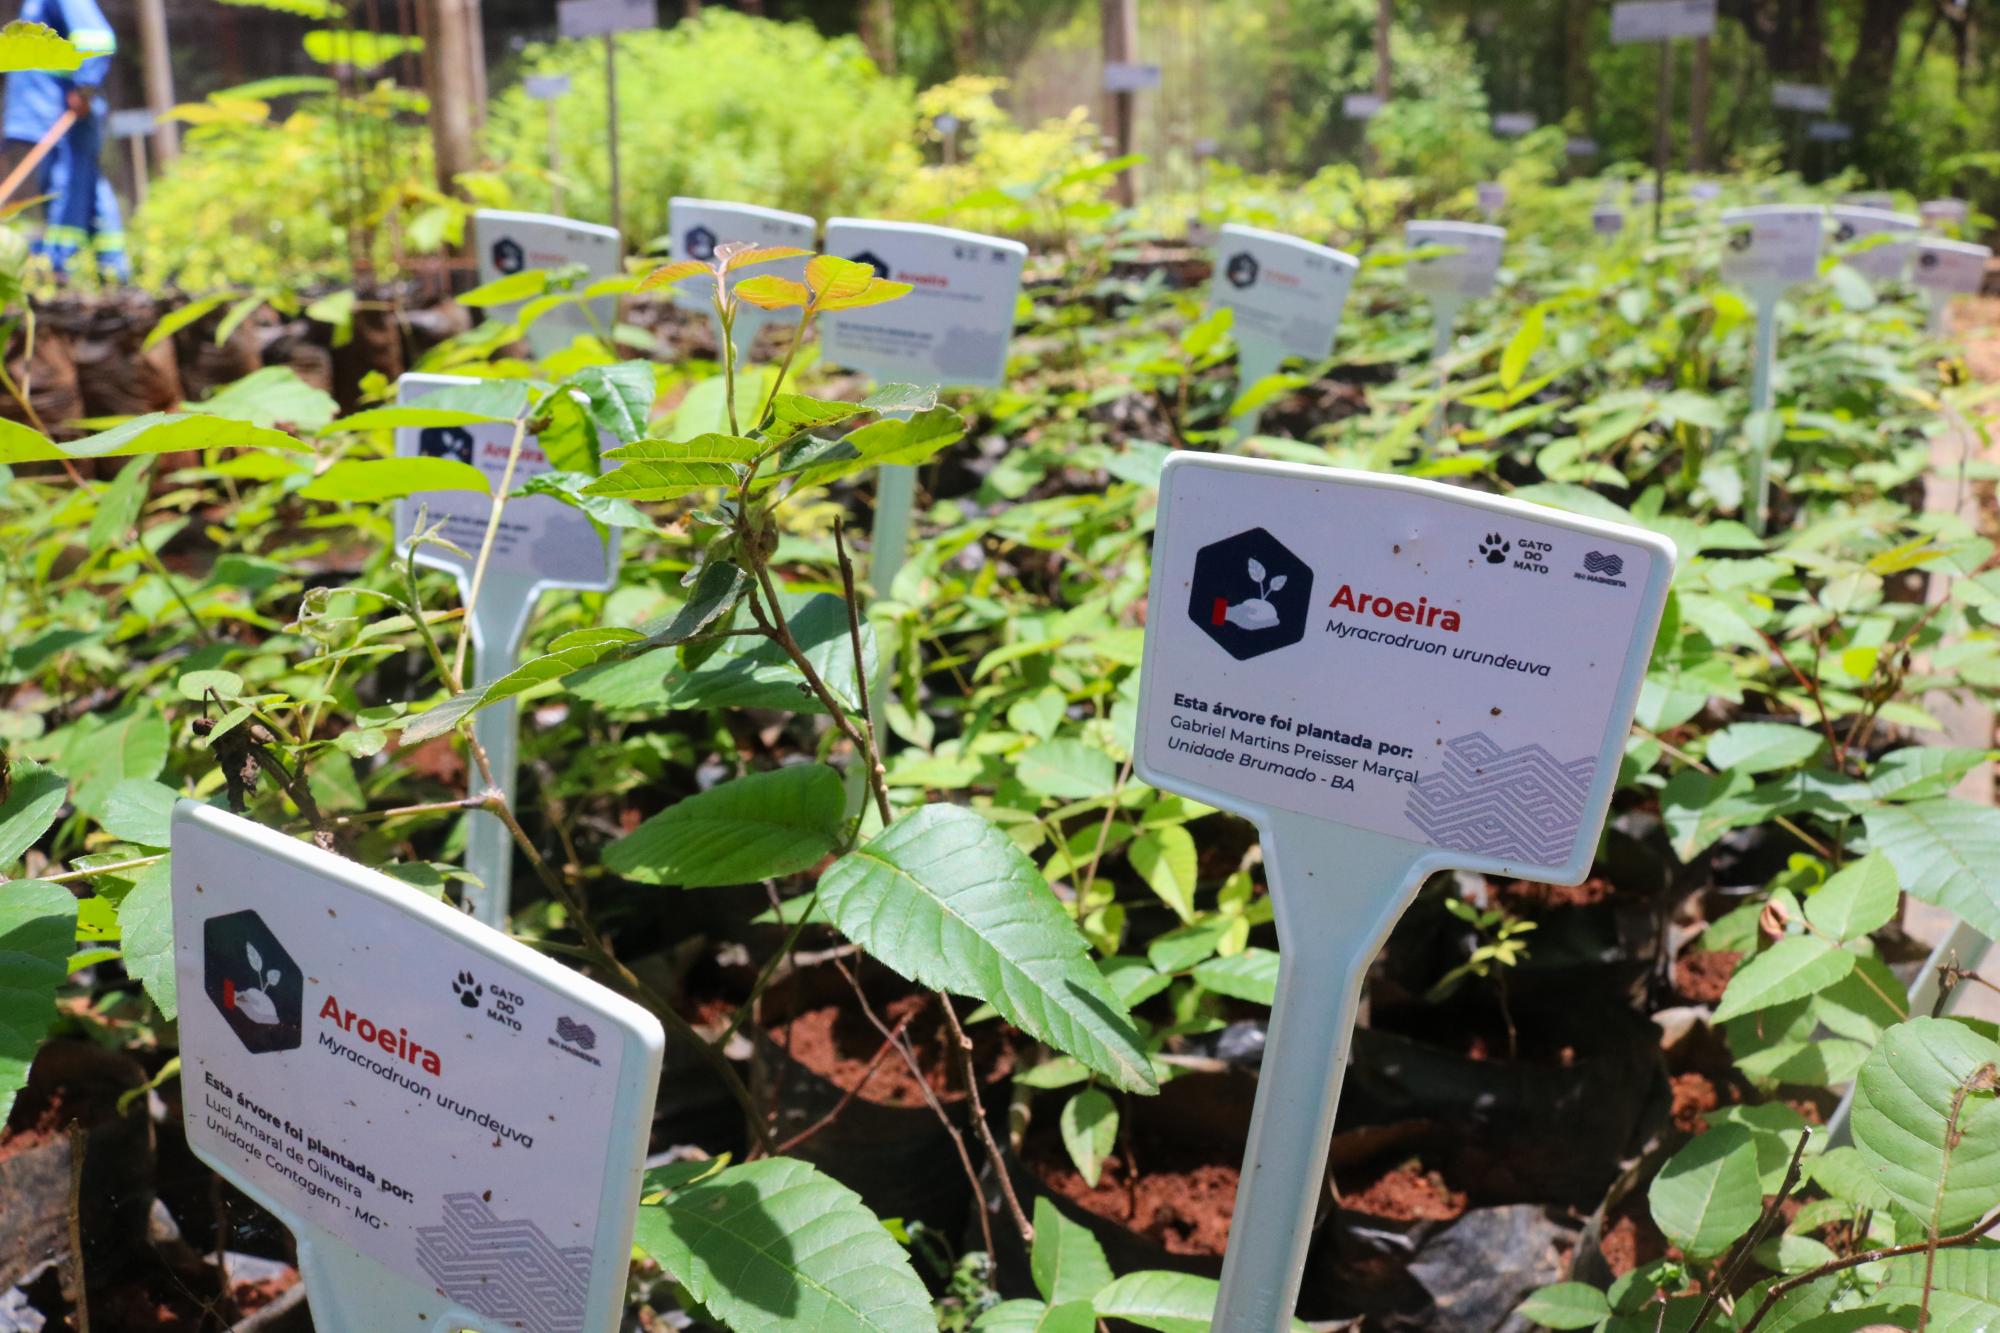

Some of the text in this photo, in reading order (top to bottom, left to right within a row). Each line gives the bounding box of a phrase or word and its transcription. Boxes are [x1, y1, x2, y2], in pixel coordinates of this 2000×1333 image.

[1513, 560, 1549, 574] MATO
[1518, 539, 1552, 552] GATO
[1524, 551, 1542, 562] DO
[1329, 584, 1462, 633] Aroeira
[1325, 619, 1551, 677] Myracrodruon urundeuva
[1170, 715, 1419, 784] Gabriel Martins Preisser Marçal
[1173, 693, 1413, 759] Esta árvore foi plantada por:
[1168, 736, 1235, 763] Unidade
[1239, 754, 1317, 783] Brumado
[1330, 775, 1356, 792] BA
[487, 1008, 522, 1032] MATO
[490, 984, 525, 1007] GATO
[496, 999, 515, 1015] DO
[319, 994, 441, 1077] Aroeira
[318, 1031, 534, 1149] Myracrodruon urundeuva
[205, 1071, 414, 1204] Esta árvore foi plantada por:
[205, 1093, 363, 1199] Luci Amaral de Oliveira
[206, 1116, 262, 1159] Unidade
[265, 1153, 341, 1208] Contagem
[354, 1206, 381, 1230] MG
